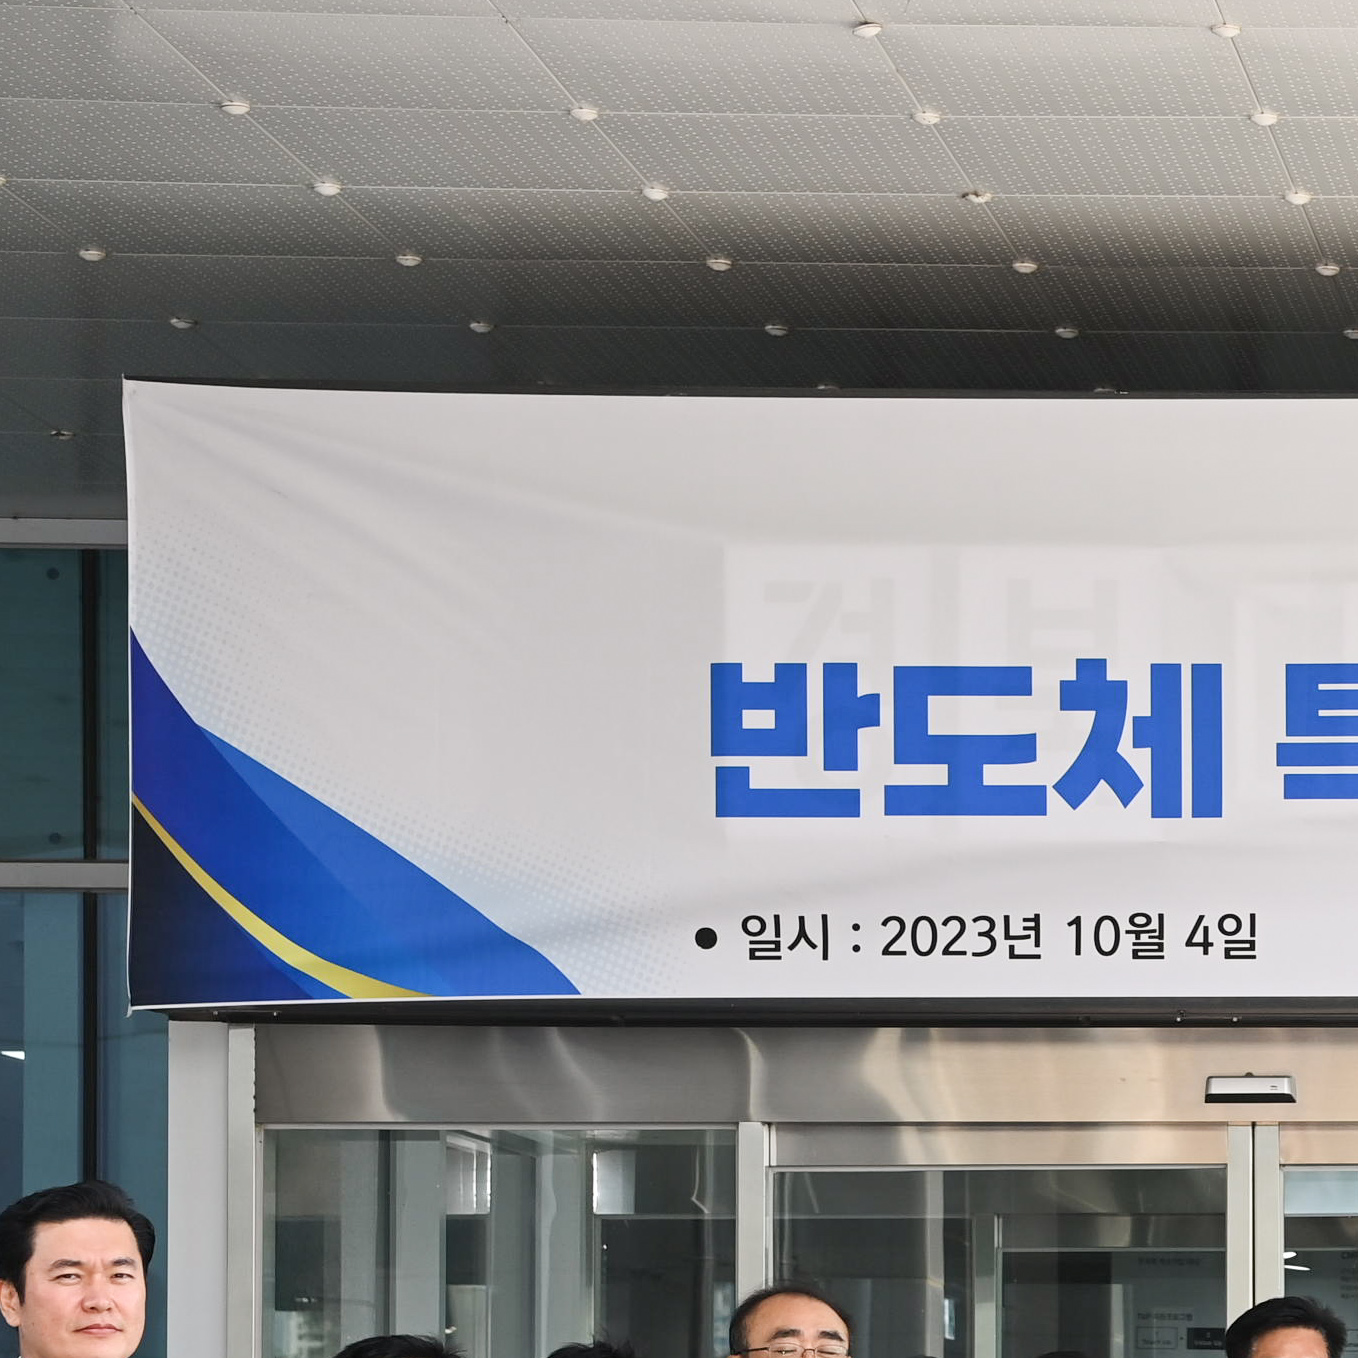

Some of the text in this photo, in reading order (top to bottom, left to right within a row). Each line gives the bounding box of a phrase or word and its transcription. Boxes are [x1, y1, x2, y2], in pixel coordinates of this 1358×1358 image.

[711, 658, 1222, 818] 반도체
[742, 914, 828, 960] 일시
[882, 914, 1041, 959] 2023년
[1068, 913, 1164, 959] 10월
[1185, 914, 1256, 959] 4일
